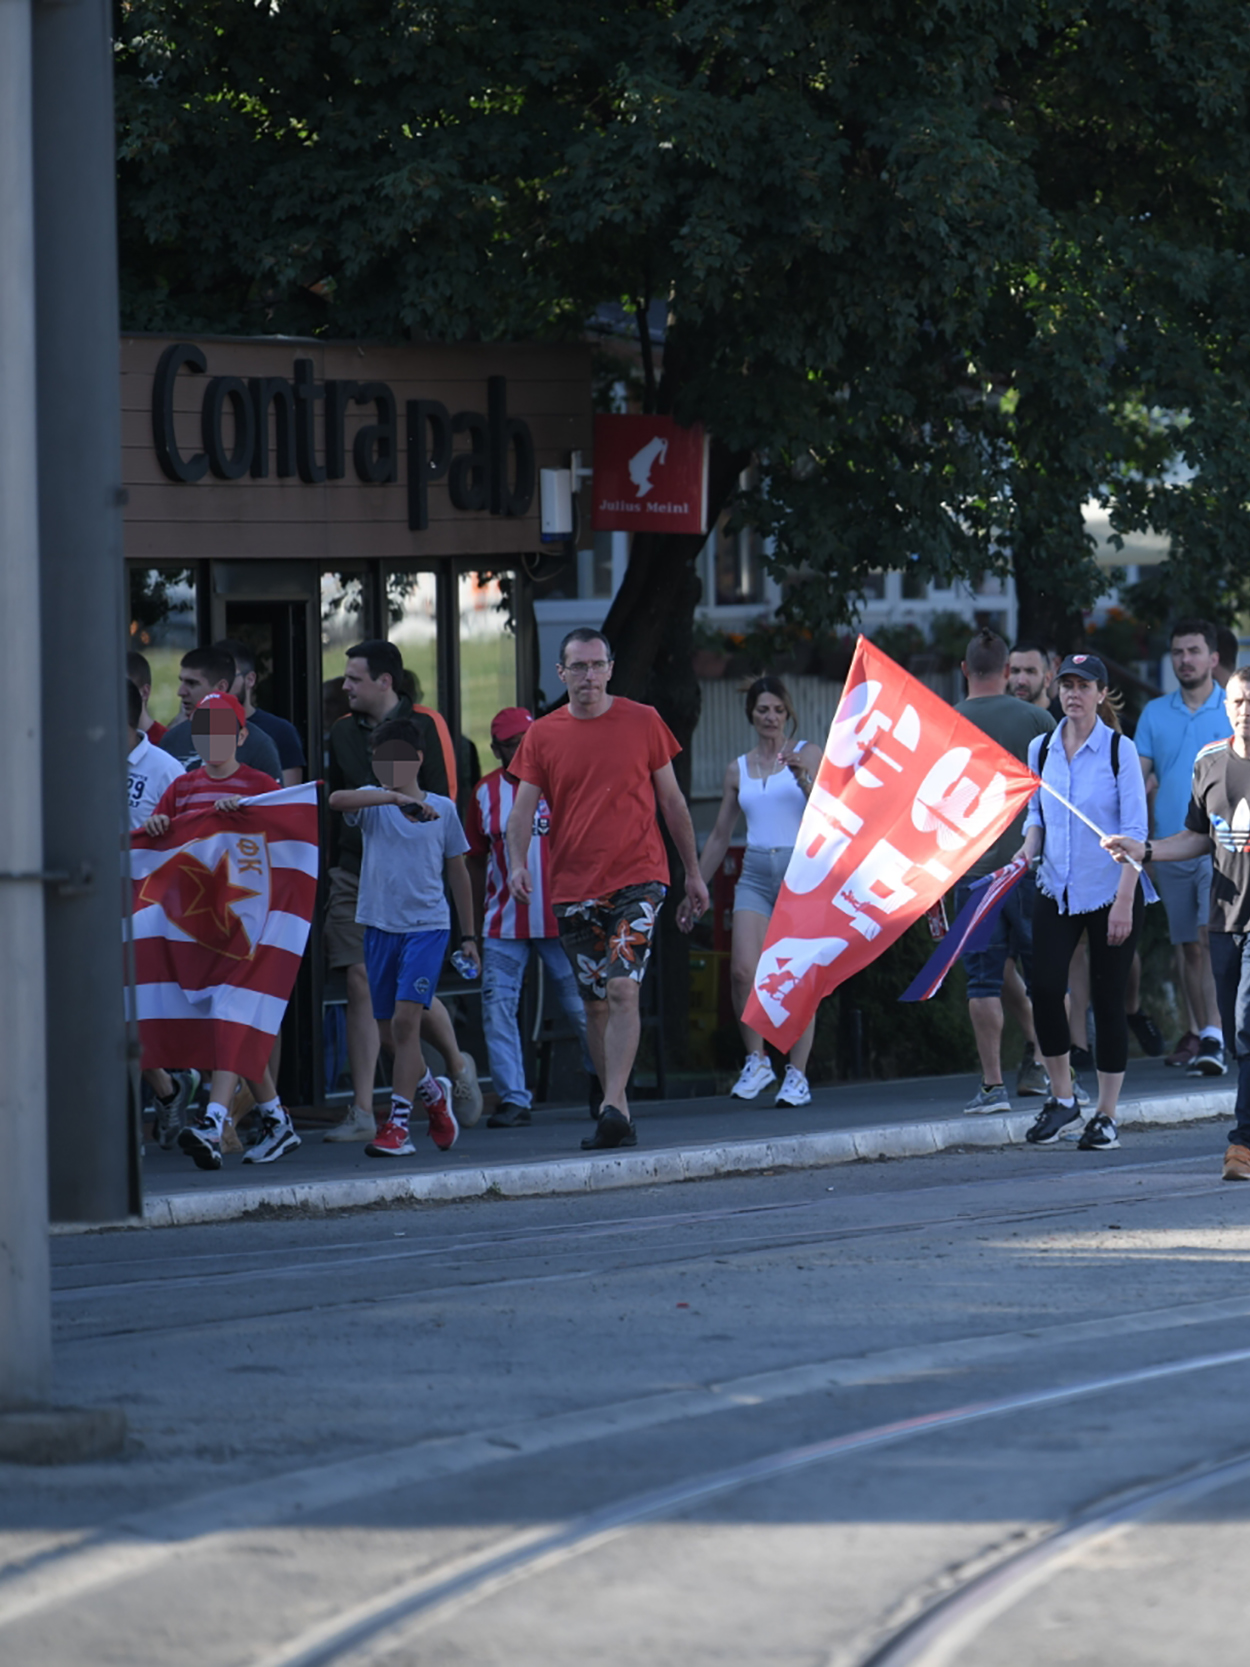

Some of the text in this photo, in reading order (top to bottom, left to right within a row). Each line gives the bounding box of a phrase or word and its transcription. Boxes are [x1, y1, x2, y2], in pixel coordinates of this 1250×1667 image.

[152, 343, 536, 531] Contra pab
[600, 500, 689, 514] Julius Meinl
